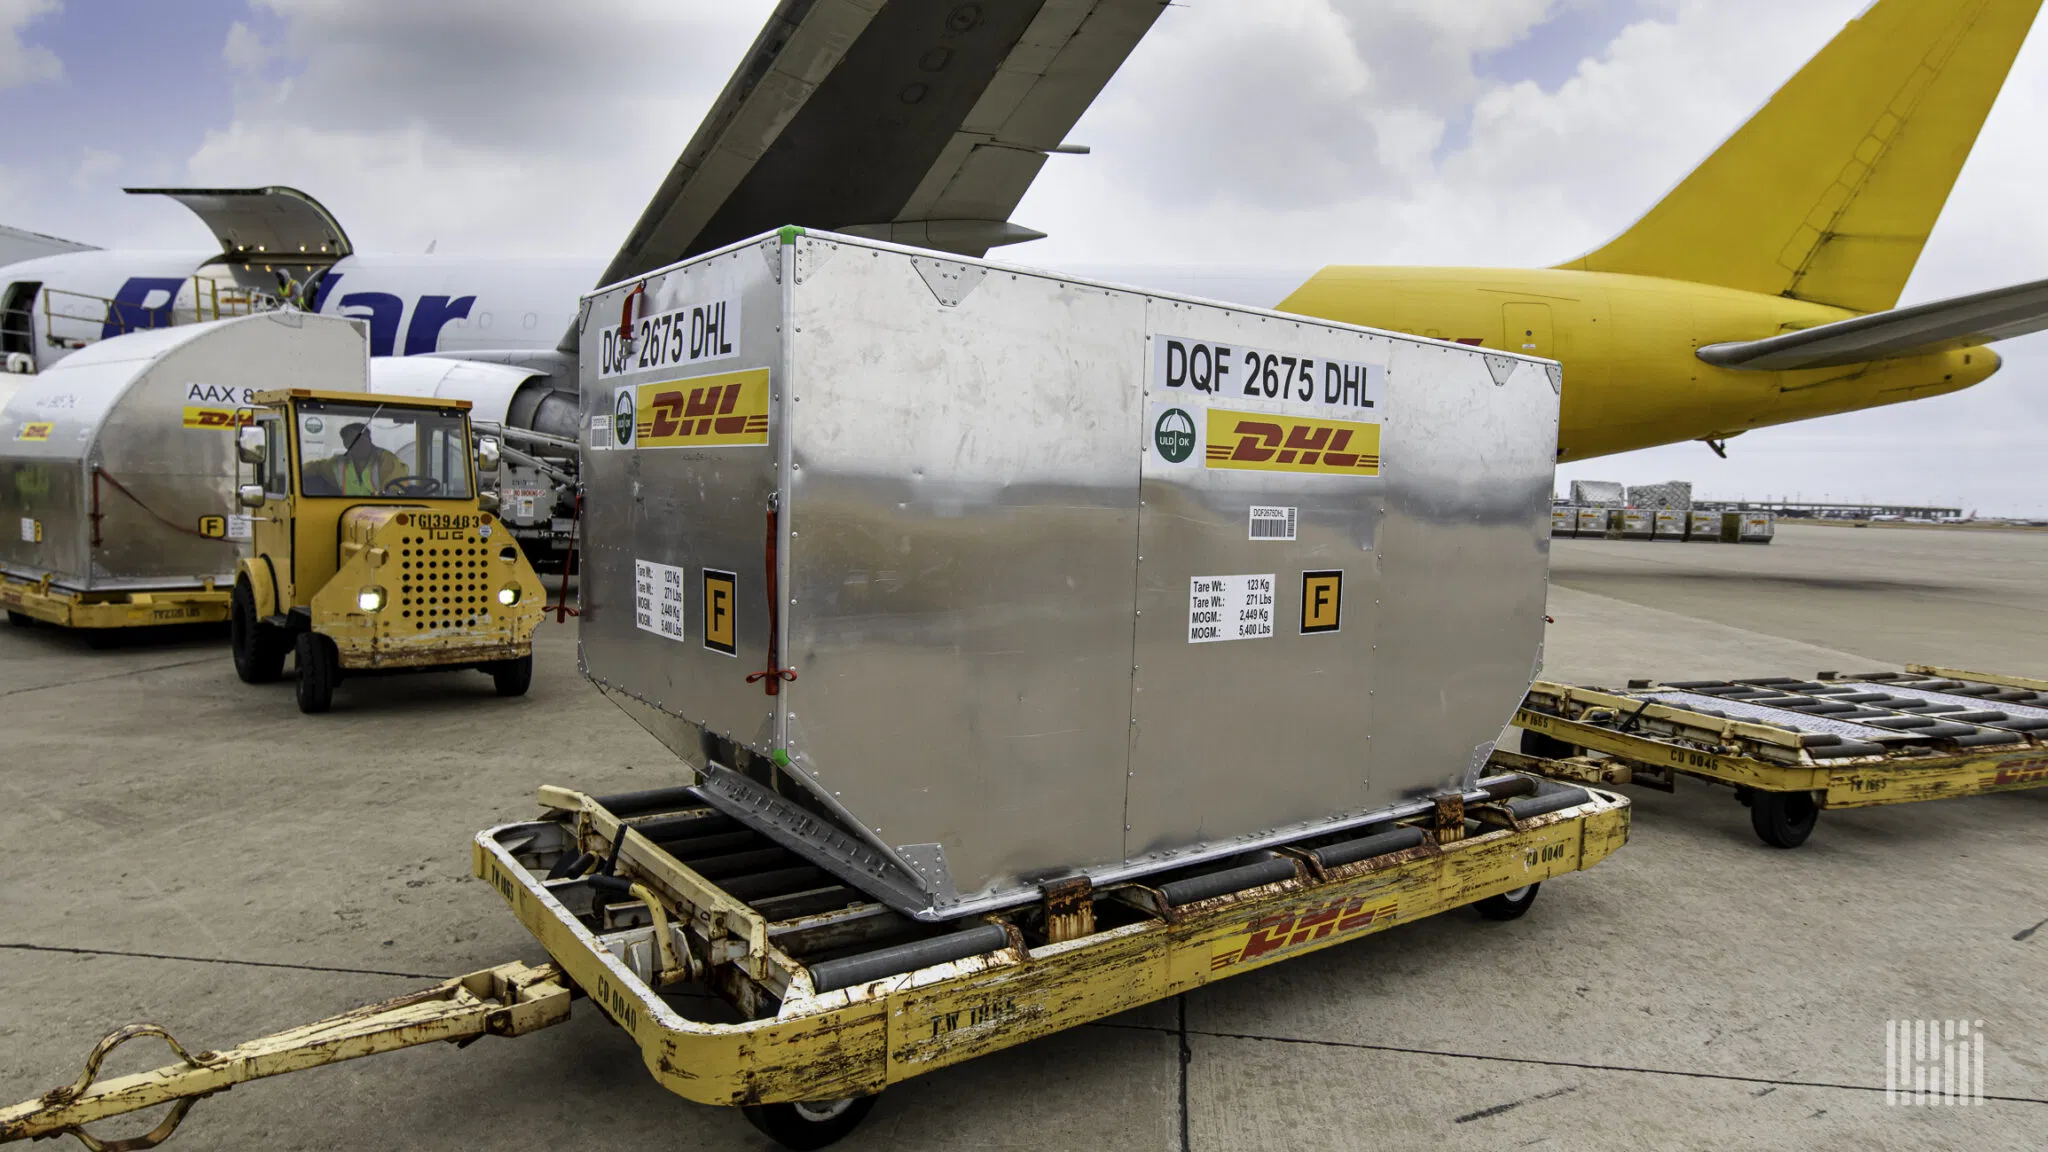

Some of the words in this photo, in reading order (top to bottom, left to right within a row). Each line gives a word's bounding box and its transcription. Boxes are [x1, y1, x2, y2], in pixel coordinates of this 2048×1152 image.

[639, 312, 684, 369] 2675
[690, 300, 732, 360] DHL
[1166, 340, 1231, 395] DQF
[1244, 351, 1314, 402] 2675
[1324, 362, 1374, 408] DHL
[188, 384, 236, 403] AAX
[243, 388, 263, 405] 8
[198, 411, 254, 427] DH
[650, 384, 748, 438] DHL
[1160, 436, 1174, 446] ULD
[1178, 437, 1190, 447] OK
[1230, 420, 1360, 467] DHL
[207, 520, 218, 534] F
[673, 572, 680, 588] Kg
[1194, 582, 1210, 592] Tare
[1247, 579, 1258, 590] 123
[1260, 578, 1270, 592] Kg
[673, 588, 682, 603] Lbs
[1193, 597, 1210, 608] Tare
[1246, 594, 1258, 606] 271
[1259, 594, 1272, 605] Lbs
[1314, 585, 1330, 618] F
[673, 605, 680, 622] Kg
[714, 590, 726, 632] F
[1240, 610, 1258, 622] 2,449
[1259, 609, 1268, 622] Kg
[673, 622, 682, 637] Lbs
[1239, 625, 1257, 637] 5,400
[1258, 624, 1270, 635] Lbs
[1670, 750, 1684, 762] CD
[1526, 848, 1538, 866] CD
[1542, 844, 1564, 864] 0040
[1239, 896, 1376, 962] DHL
[598, 974, 610, 1004] CD
[612, 988, 637, 1033] 0040
